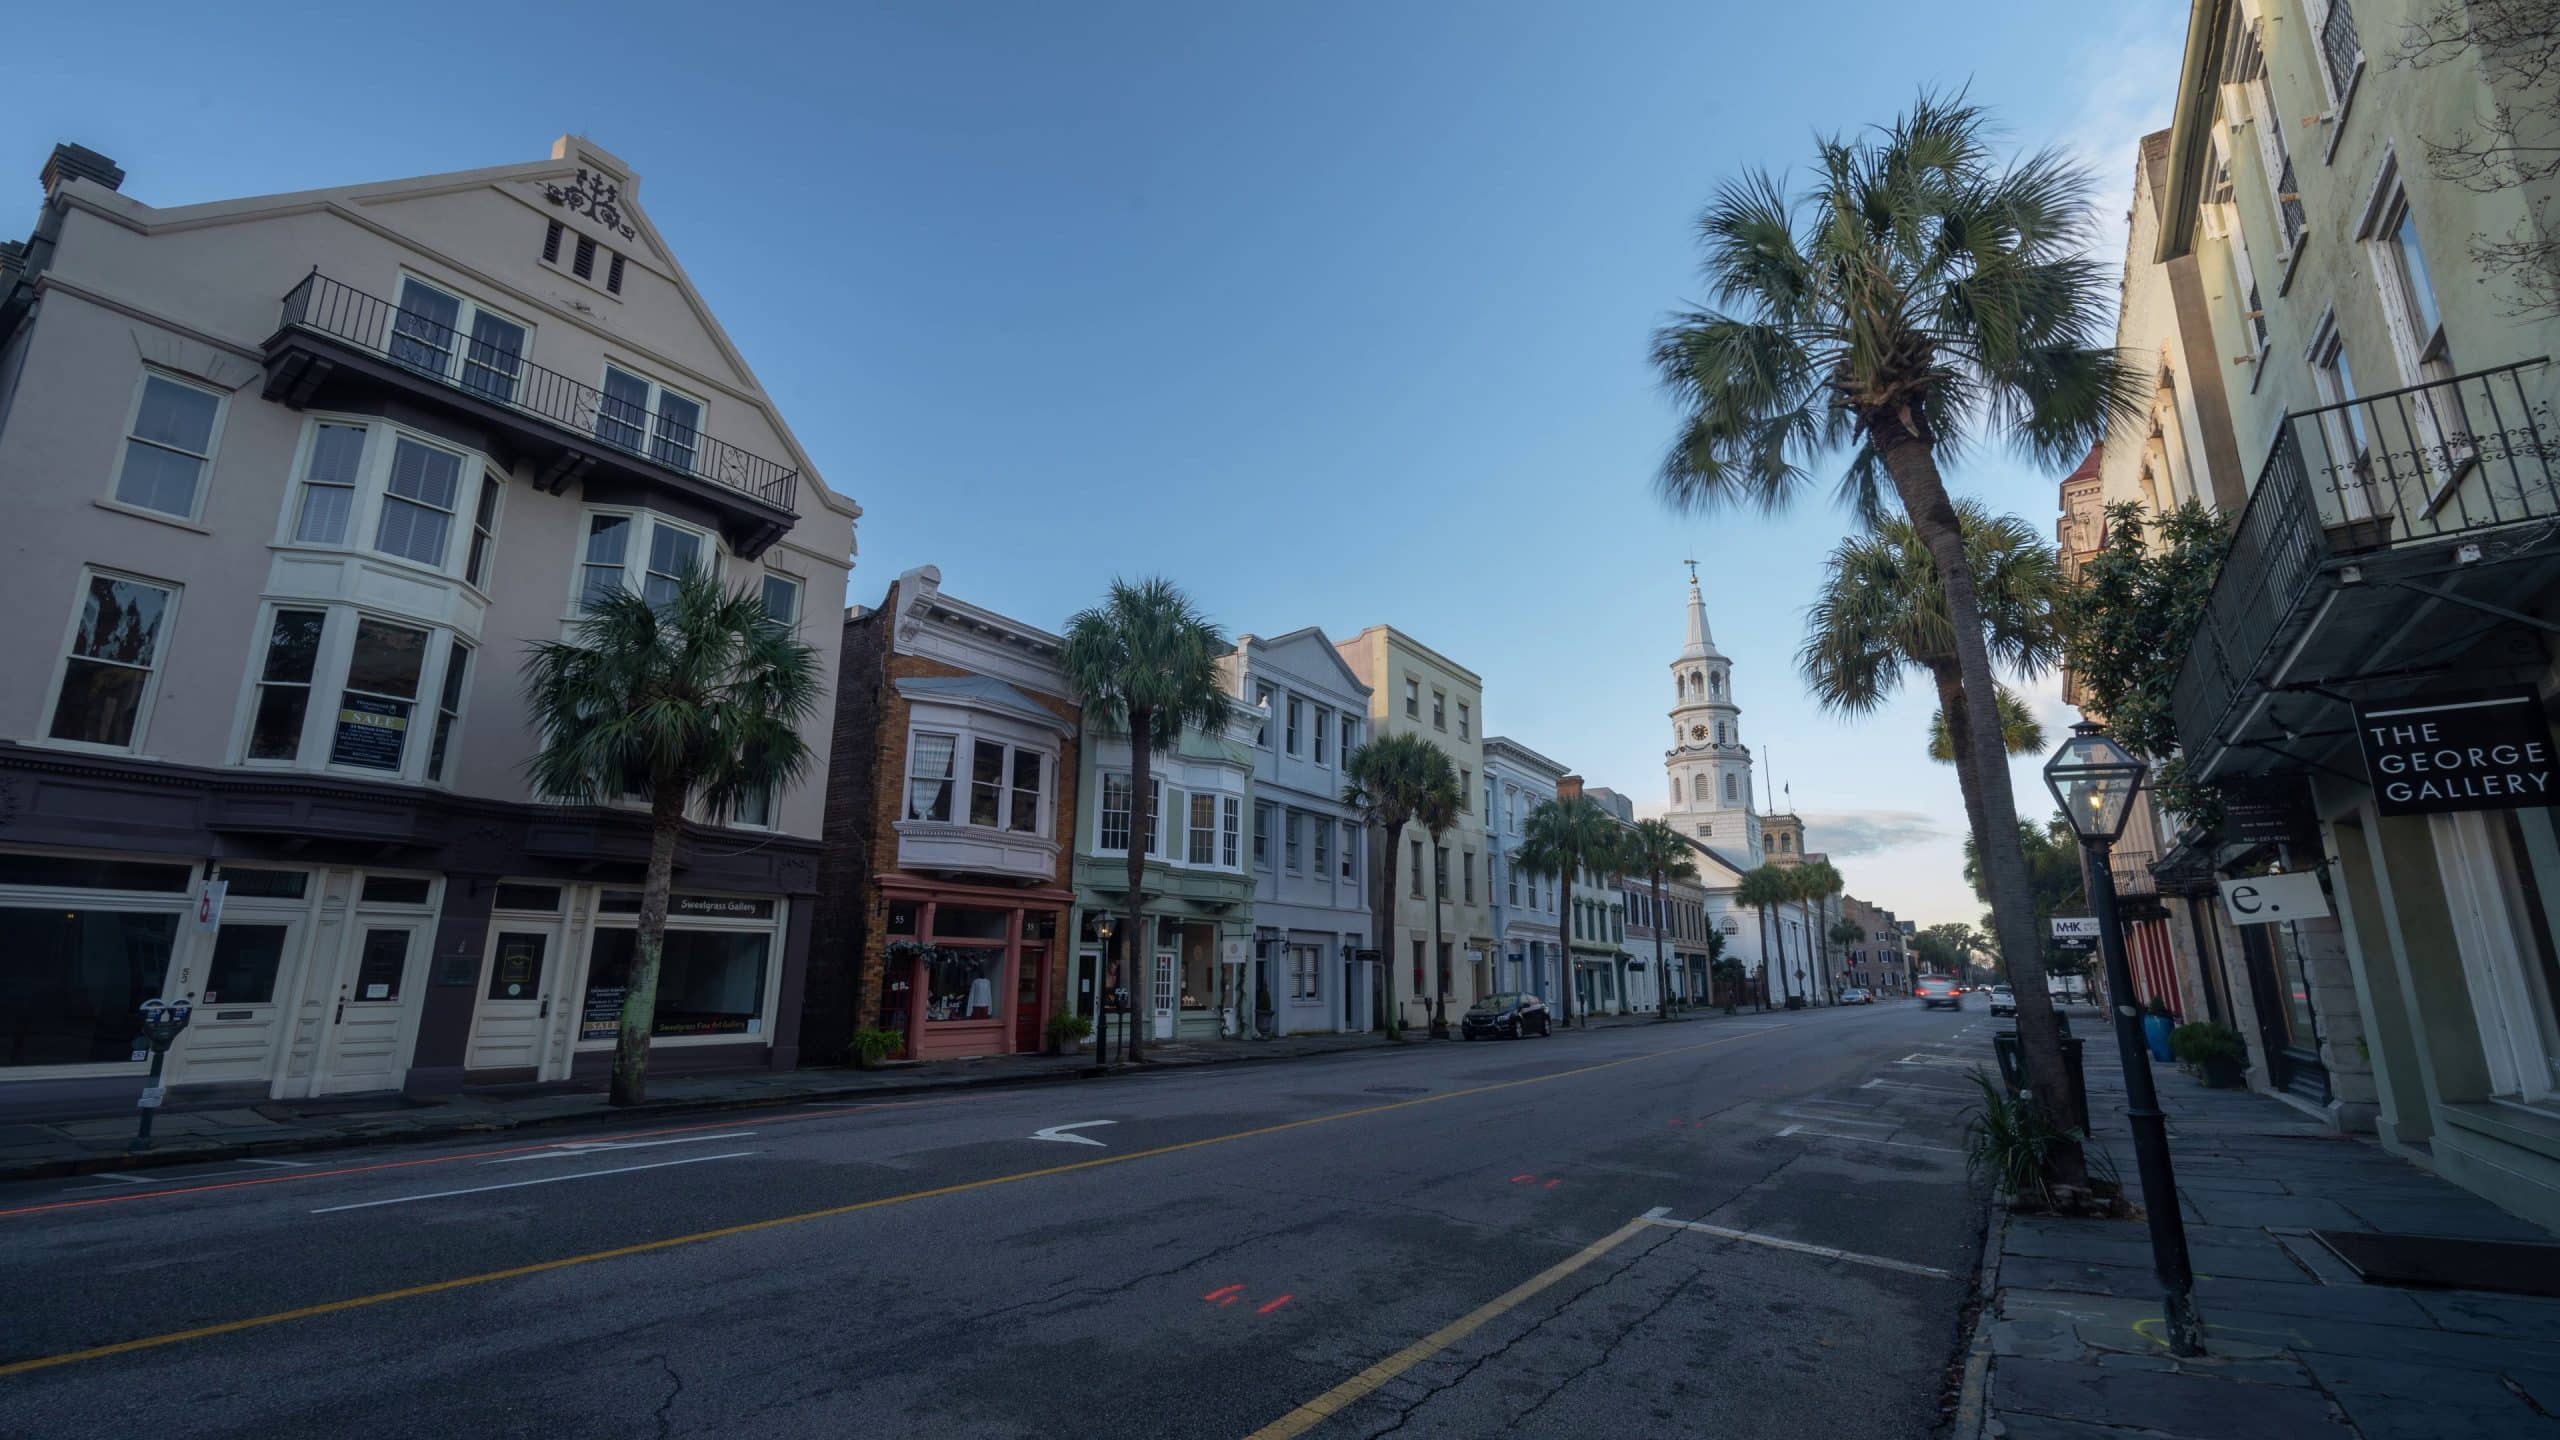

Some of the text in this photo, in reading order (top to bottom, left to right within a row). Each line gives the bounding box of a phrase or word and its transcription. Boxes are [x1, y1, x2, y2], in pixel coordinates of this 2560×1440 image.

[353, 713, 393, 727] SALE
[2369, 722, 2441, 747] THE
[2379, 742, 2546, 774] GEORGE
[2386, 771, 2550, 802] GALLERY
[681, 899, 756, 914] Sweetgrass Gallery
[2232, 886, 2280, 914] e.
[2056, 921, 2082, 932] MHK
